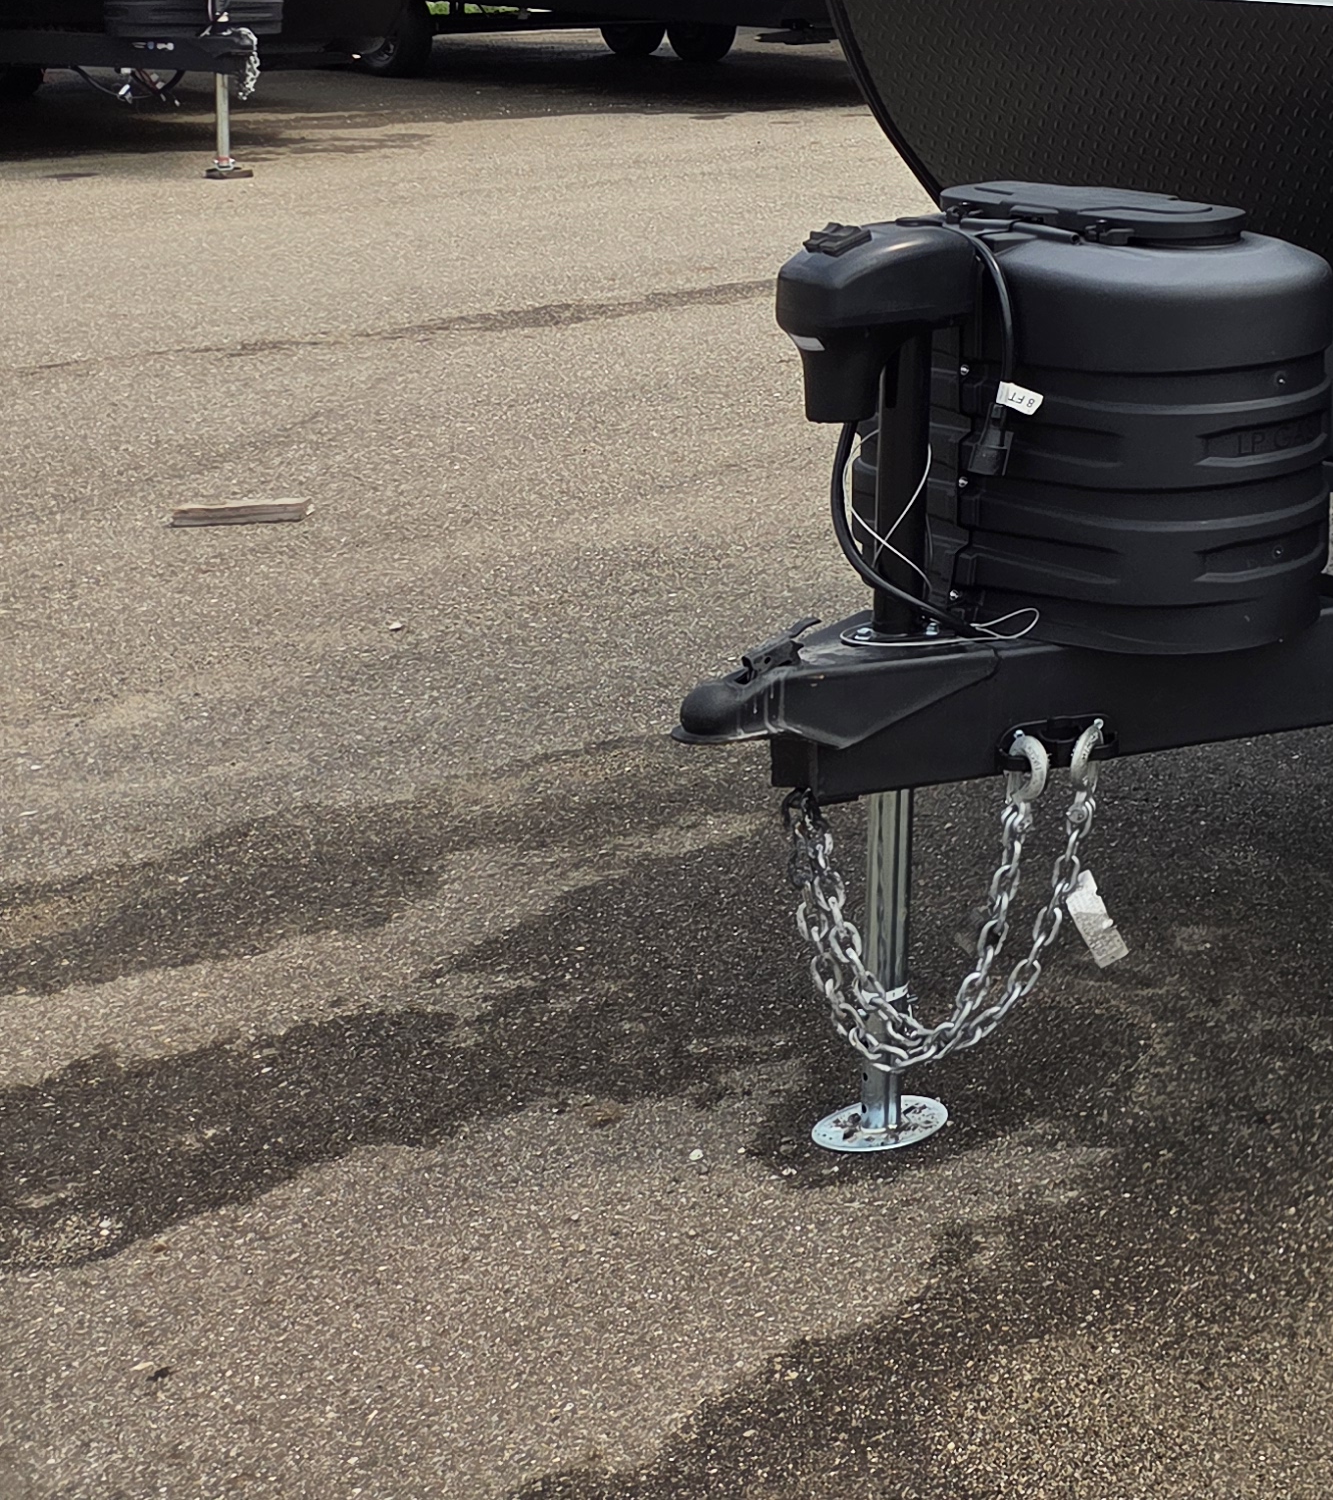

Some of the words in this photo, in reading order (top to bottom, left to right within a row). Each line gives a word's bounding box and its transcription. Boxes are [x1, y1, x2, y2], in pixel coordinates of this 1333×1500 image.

[1007, 392, 1026, 404] FT
[1026, 398, 1036, 408] 8
[1236, 431, 1266, 456] LP
